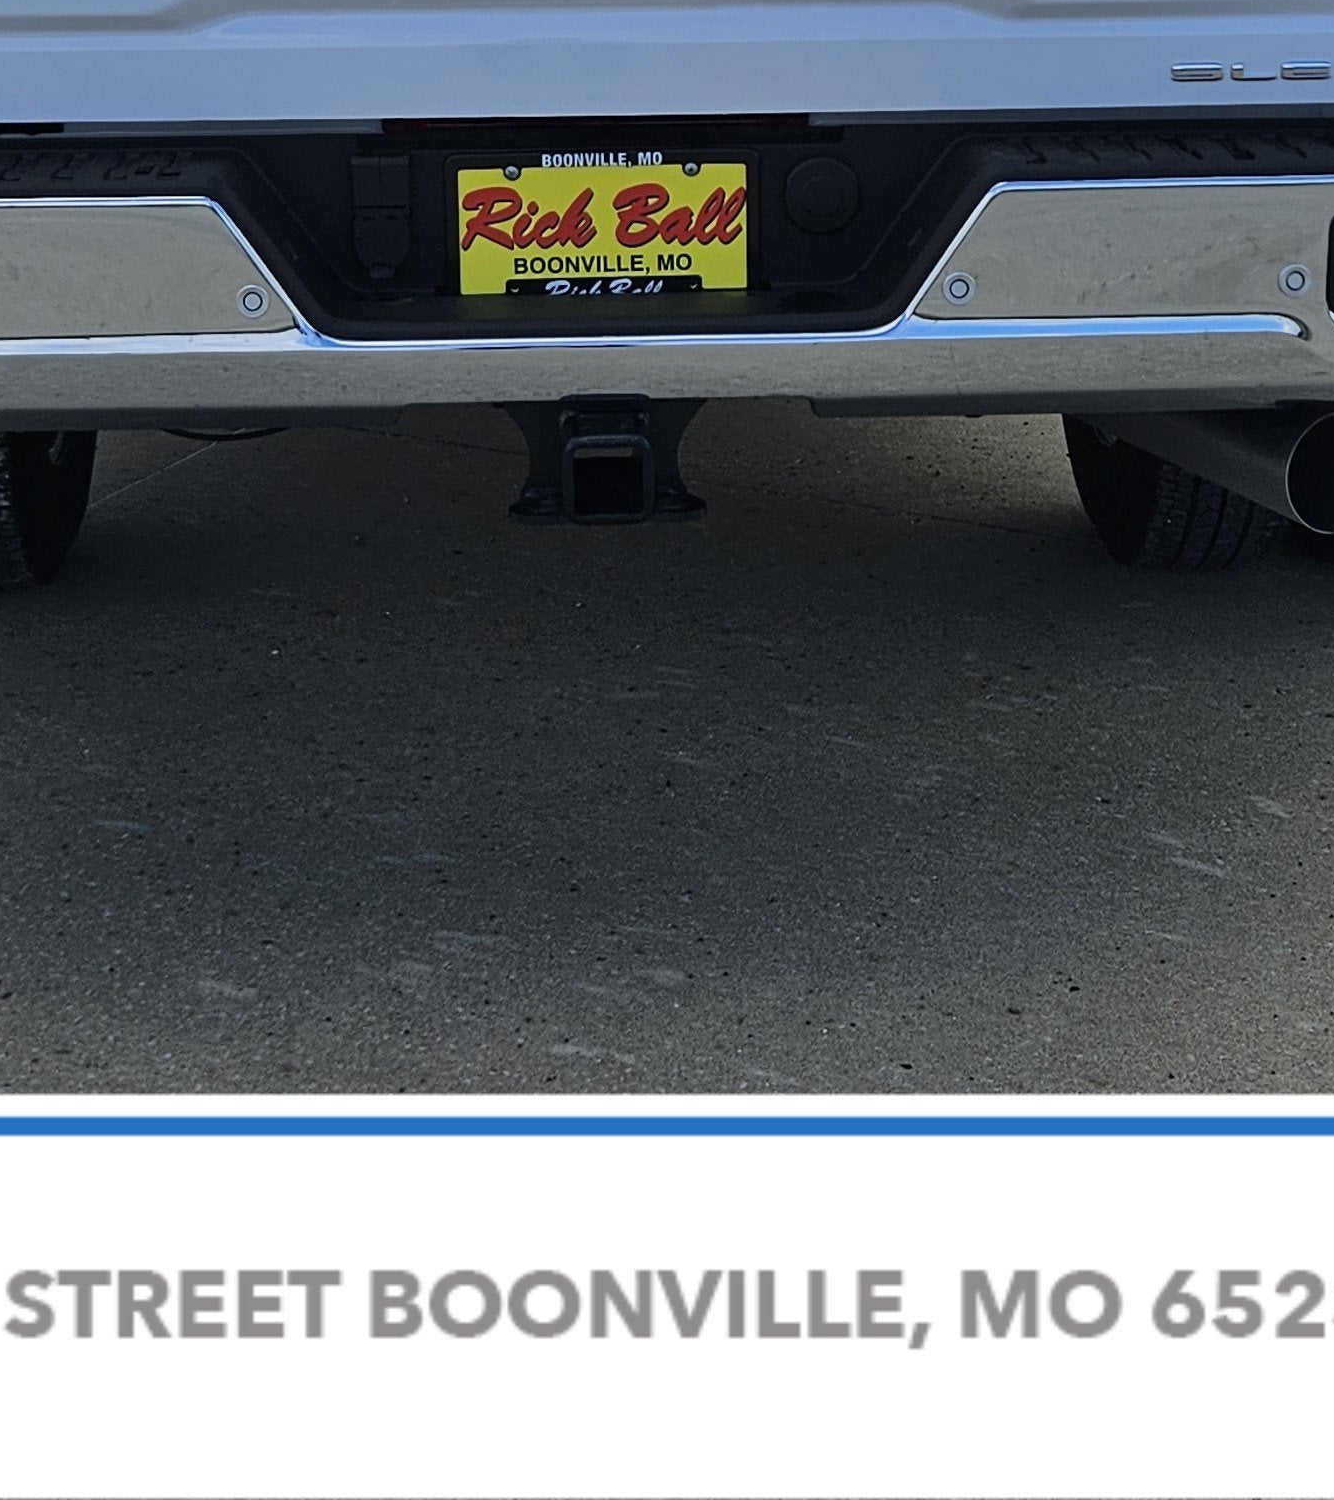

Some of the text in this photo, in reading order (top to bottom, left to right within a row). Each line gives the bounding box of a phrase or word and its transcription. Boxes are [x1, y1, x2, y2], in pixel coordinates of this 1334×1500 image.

[1170, 61, 1332, 82] SLE
[541, 151, 663, 168] BOONVILLE, MO
[461, 183, 747, 251] Rick Ball
[513, 253, 693, 276] BOONVILLE, MO
